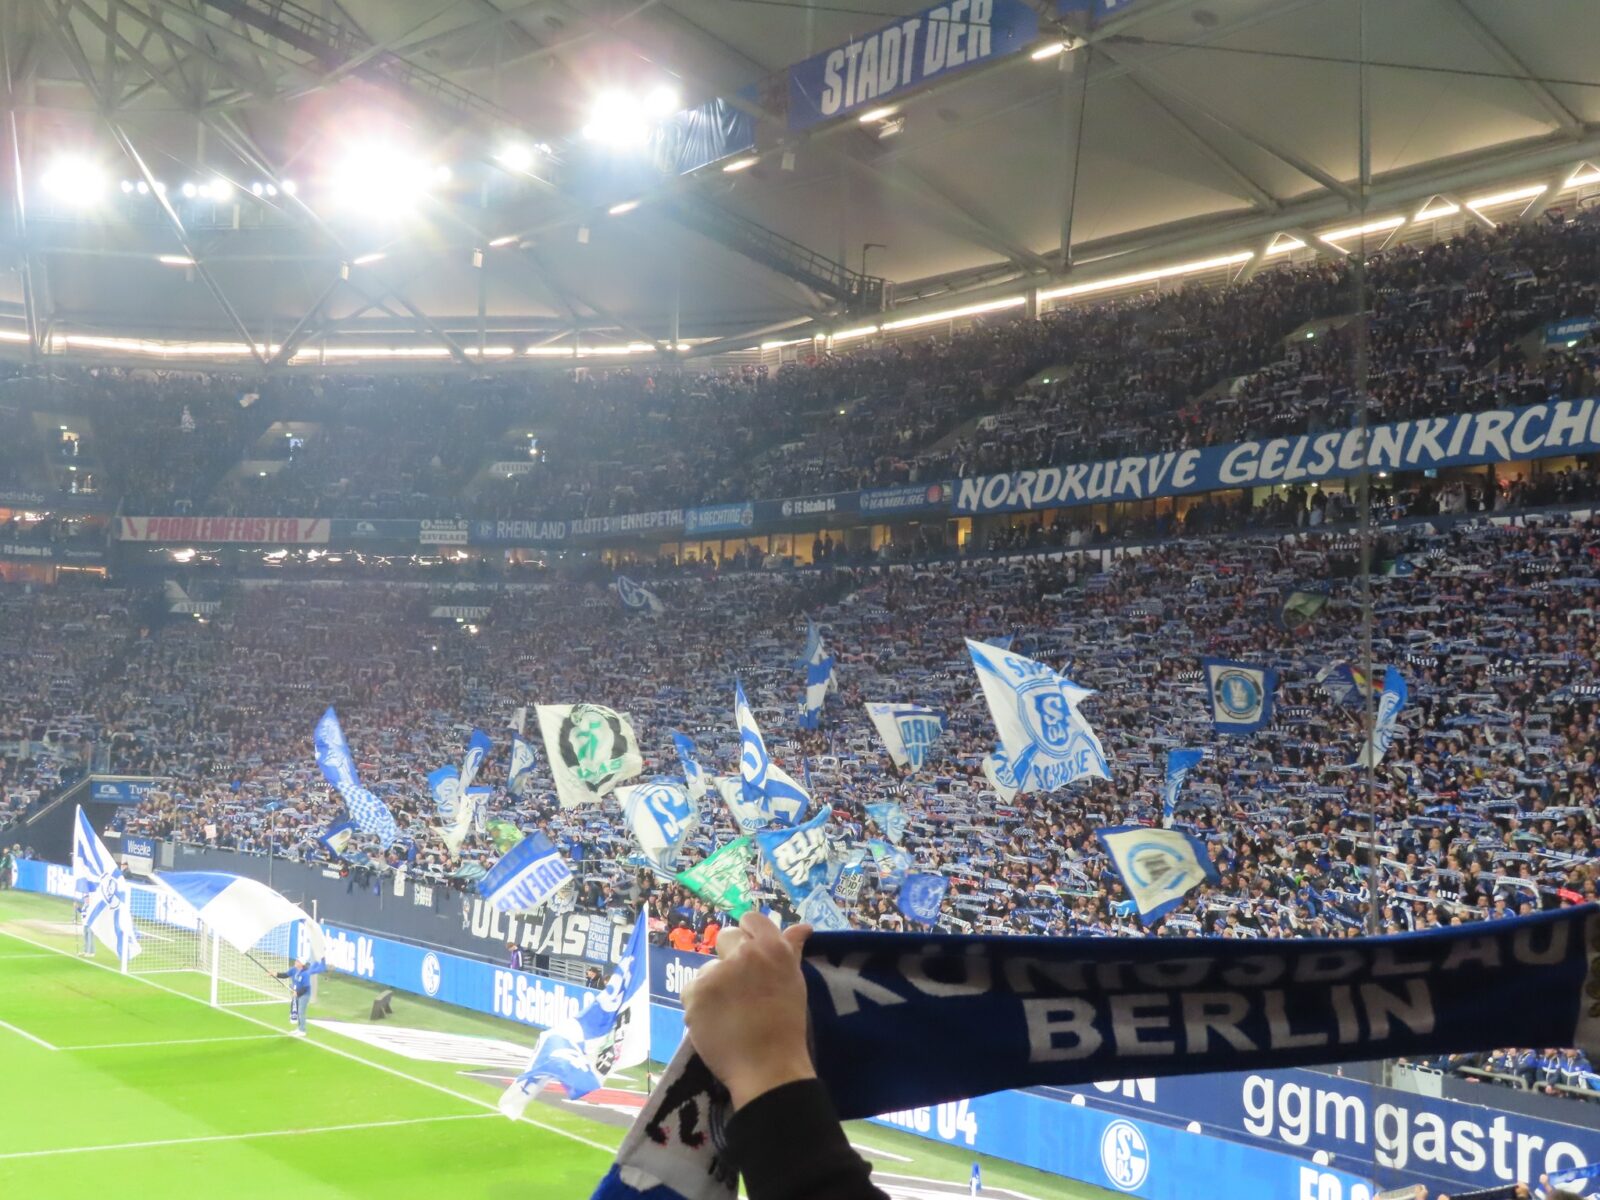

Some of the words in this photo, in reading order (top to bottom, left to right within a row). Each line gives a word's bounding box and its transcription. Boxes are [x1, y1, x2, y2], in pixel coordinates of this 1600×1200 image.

[821, 18, 920, 115] STADT
[923, 0, 992, 76] DER
[957, 449, 1201, 511] NORDKURVE
[145, 518, 300, 541] PROBLEMFENSTER
[496, 521, 565, 539] RHEINLAND
[620, 509, 684, 530] ENNEPETAL
[127, 840, 151, 857] Weseke
[472, 899, 590, 956] ULTRAS
[357, 936, 374, 977] 04
[494, 970, 513, 1016] FC
[515, 975, 580, 1027] Schalke
[1023, 978, 1436, 1063] BERLIN
